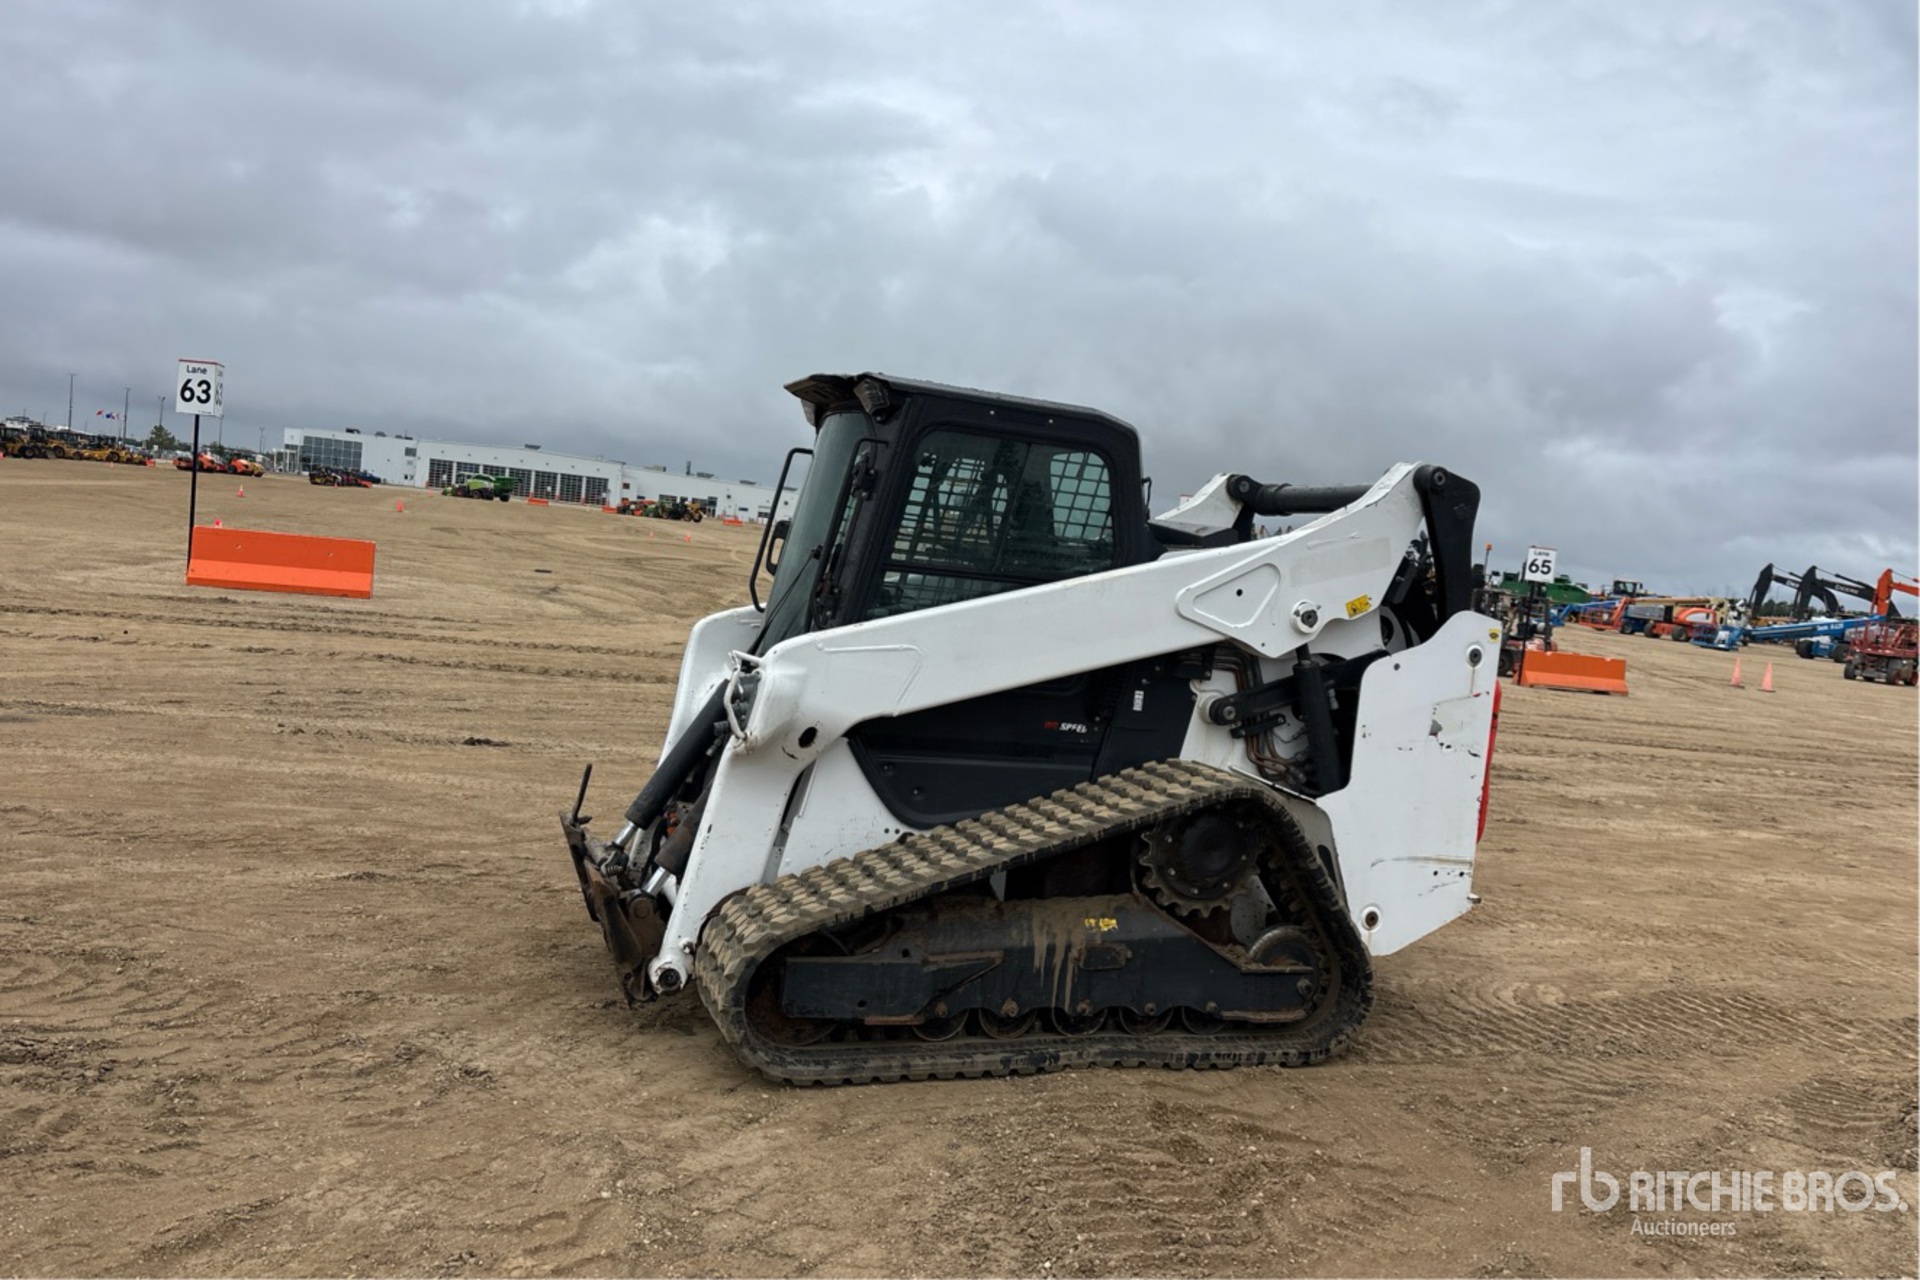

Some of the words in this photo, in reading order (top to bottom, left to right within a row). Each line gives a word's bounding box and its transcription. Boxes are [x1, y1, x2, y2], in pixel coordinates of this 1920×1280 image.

[186, 364, 208, 375] Lane
[180, 378, 211, 404] 63
[1528, 558, 1552, 575] 65
